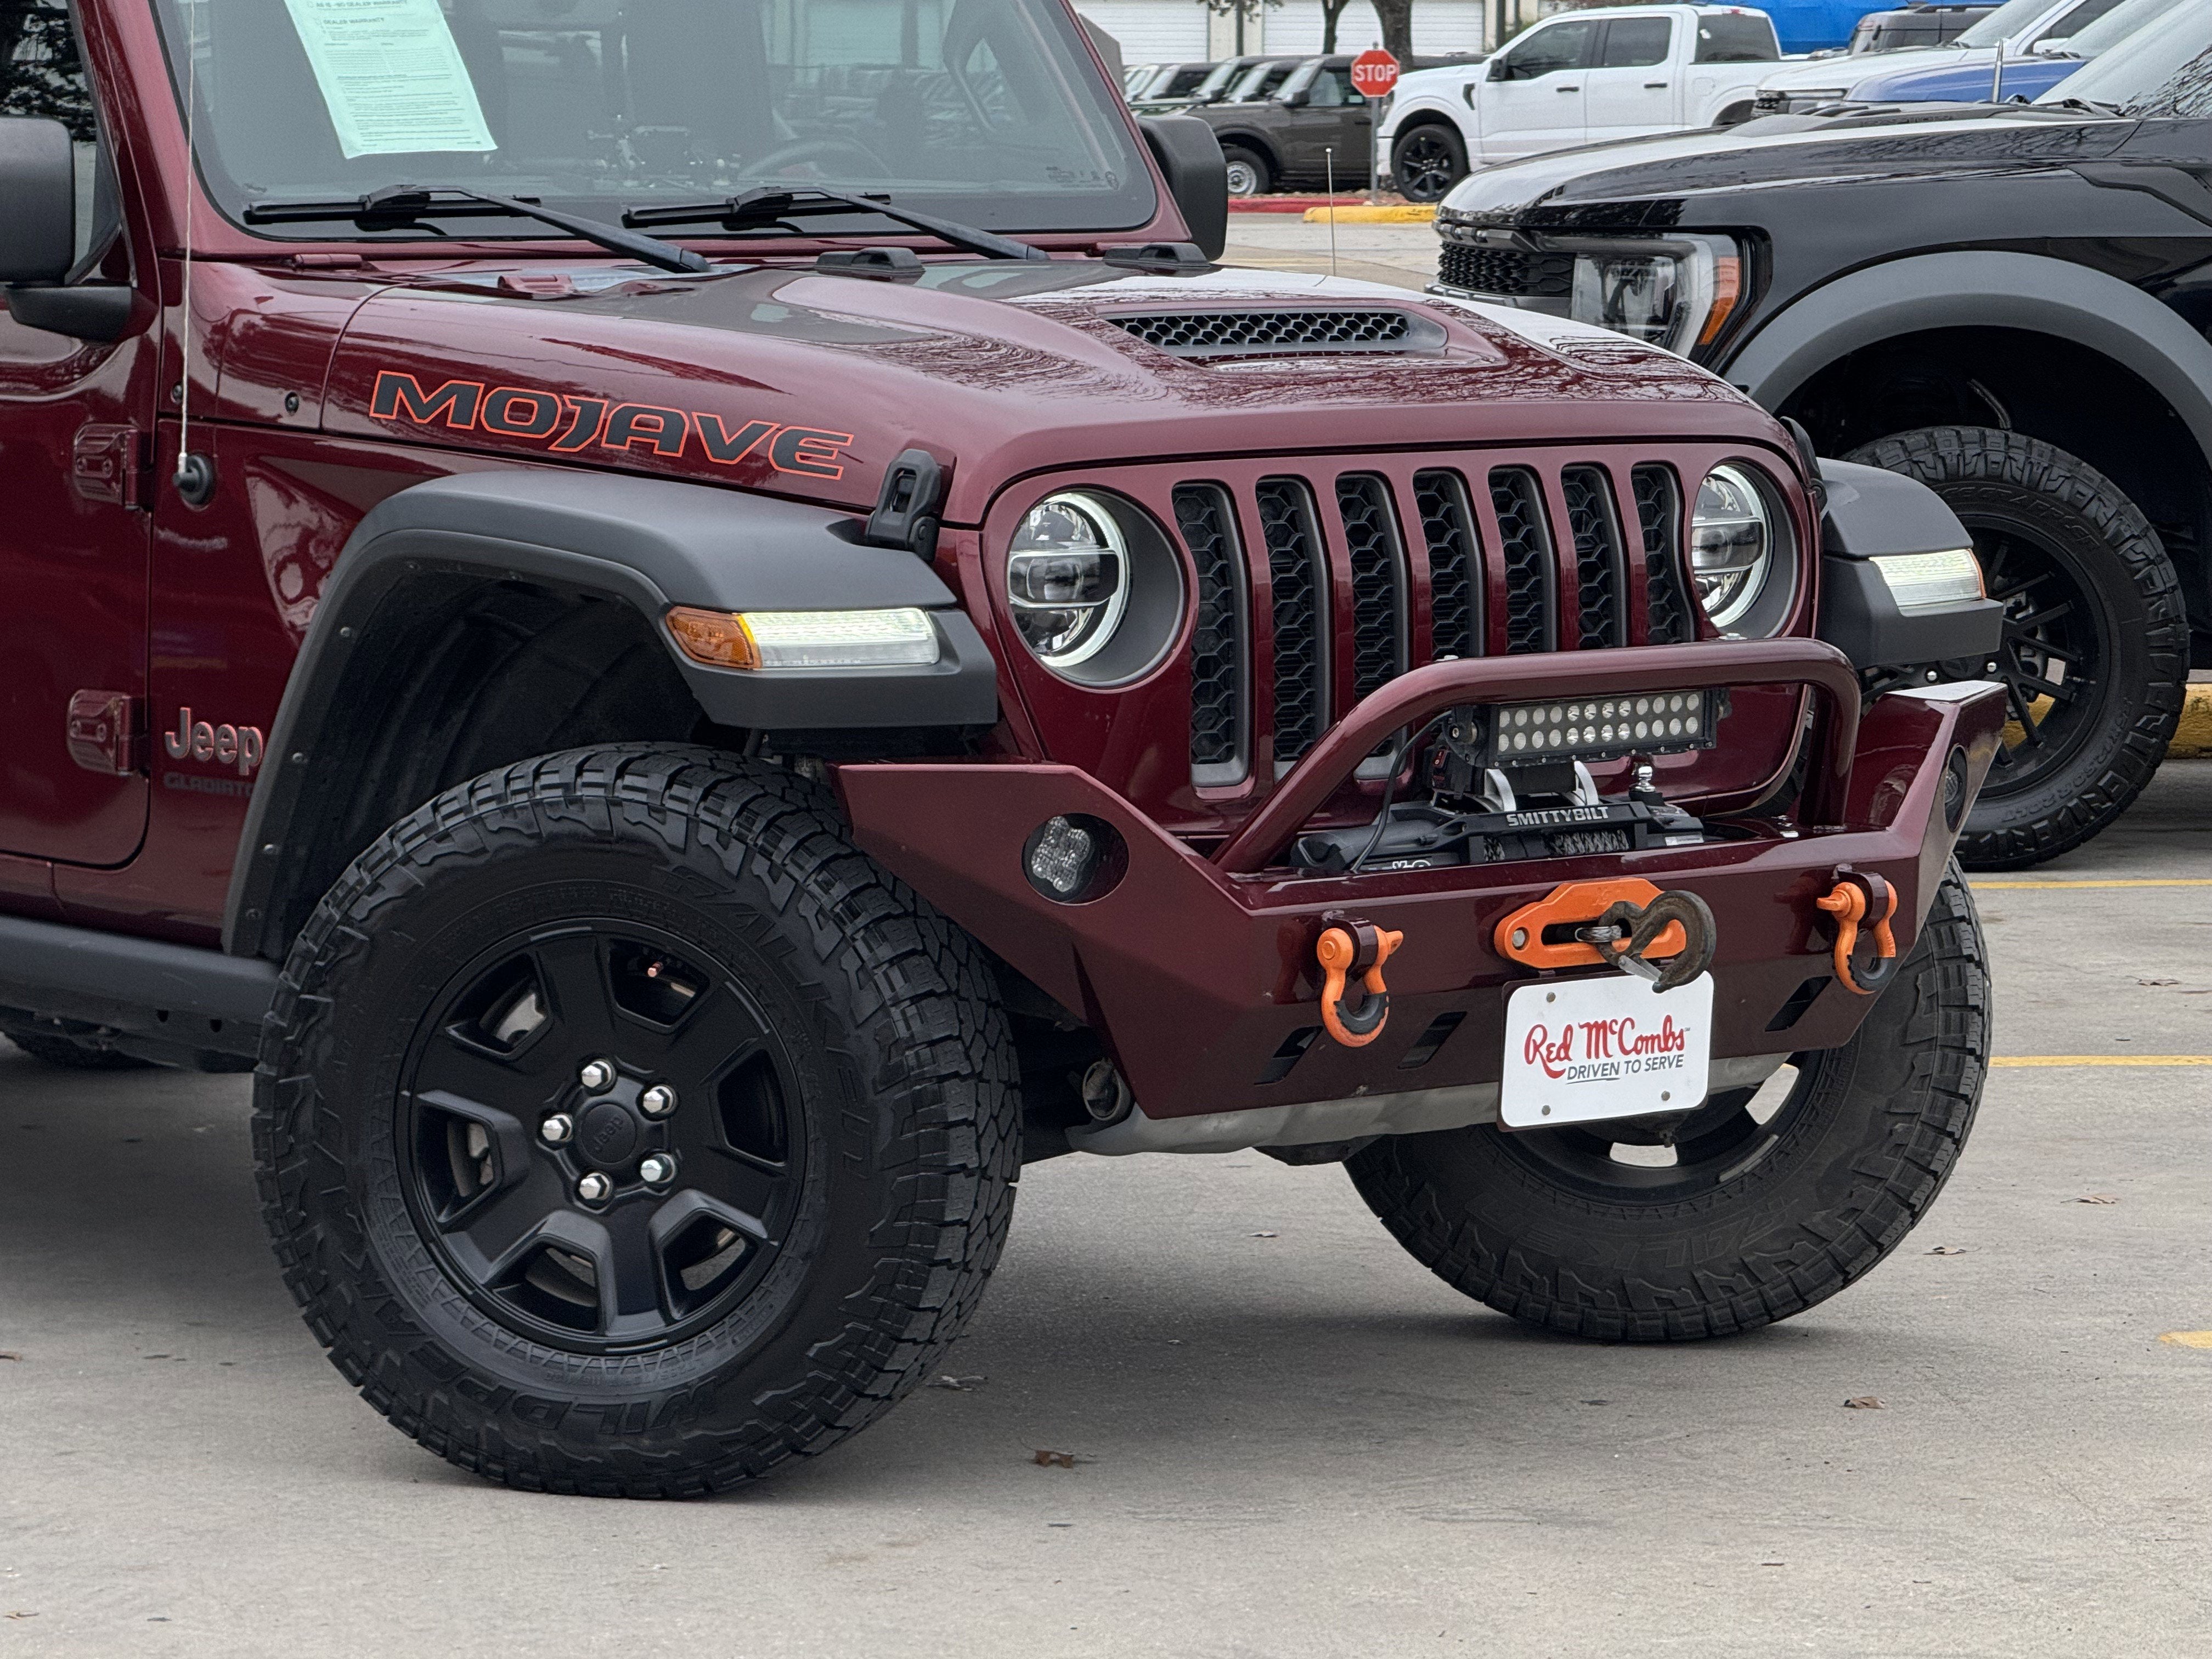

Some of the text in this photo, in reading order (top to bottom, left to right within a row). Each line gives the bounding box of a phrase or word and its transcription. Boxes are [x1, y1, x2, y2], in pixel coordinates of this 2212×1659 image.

[1355, 64, 1397, 82] STOP
[369, 370, 854, 481] MOJAVE
[165, 707, 263, 776] Jeep
[1506, 806, 1609, 826] SMITTYBILT
[1523, 1014, 1685, 1079] Red McCombs
[1567, 1054, 1685, 1081] DRIVEN TO SERVE
[593, 1114, 624, 1152] Jeep
